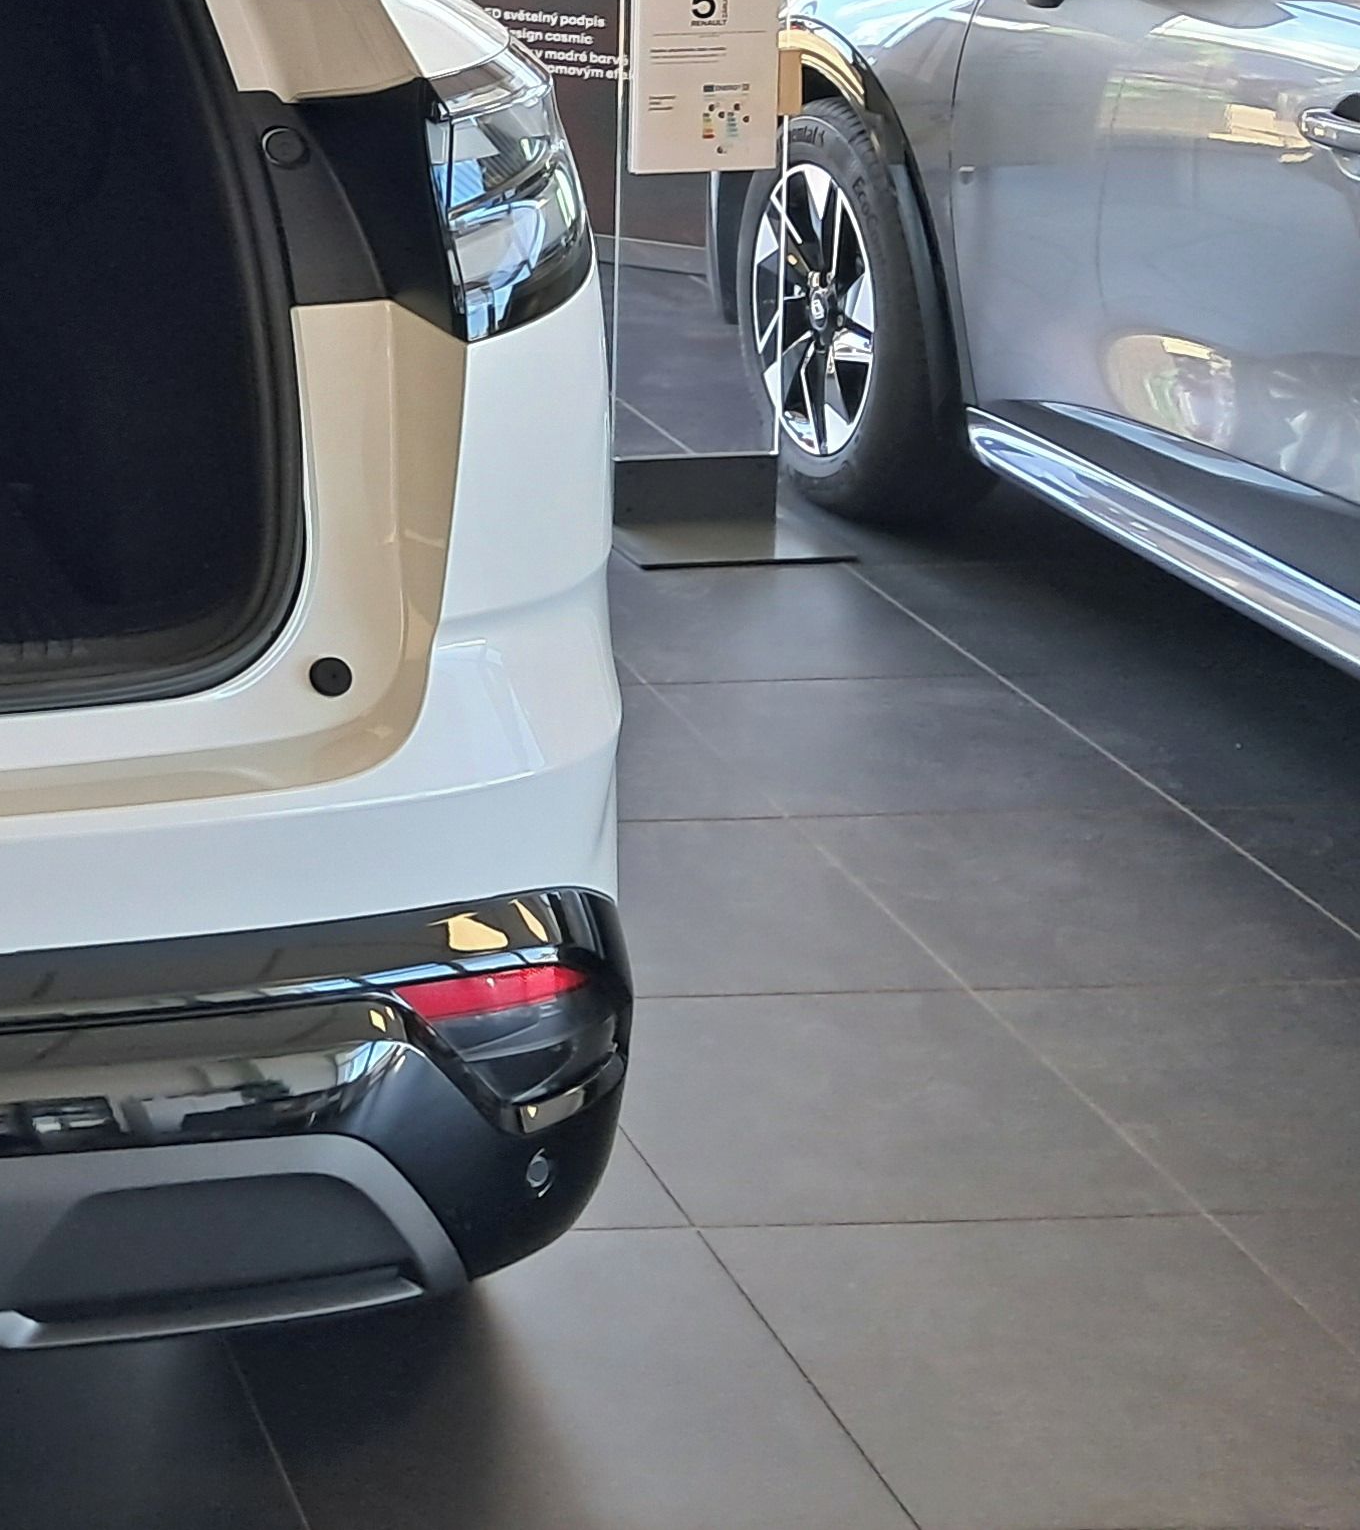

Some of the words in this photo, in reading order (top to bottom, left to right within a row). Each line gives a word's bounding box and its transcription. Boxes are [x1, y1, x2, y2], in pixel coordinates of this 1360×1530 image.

[559, 15, 607, 30] podpis
[544, 32, 595, 46] cosmic
[544, 48, 588, 63] modré
